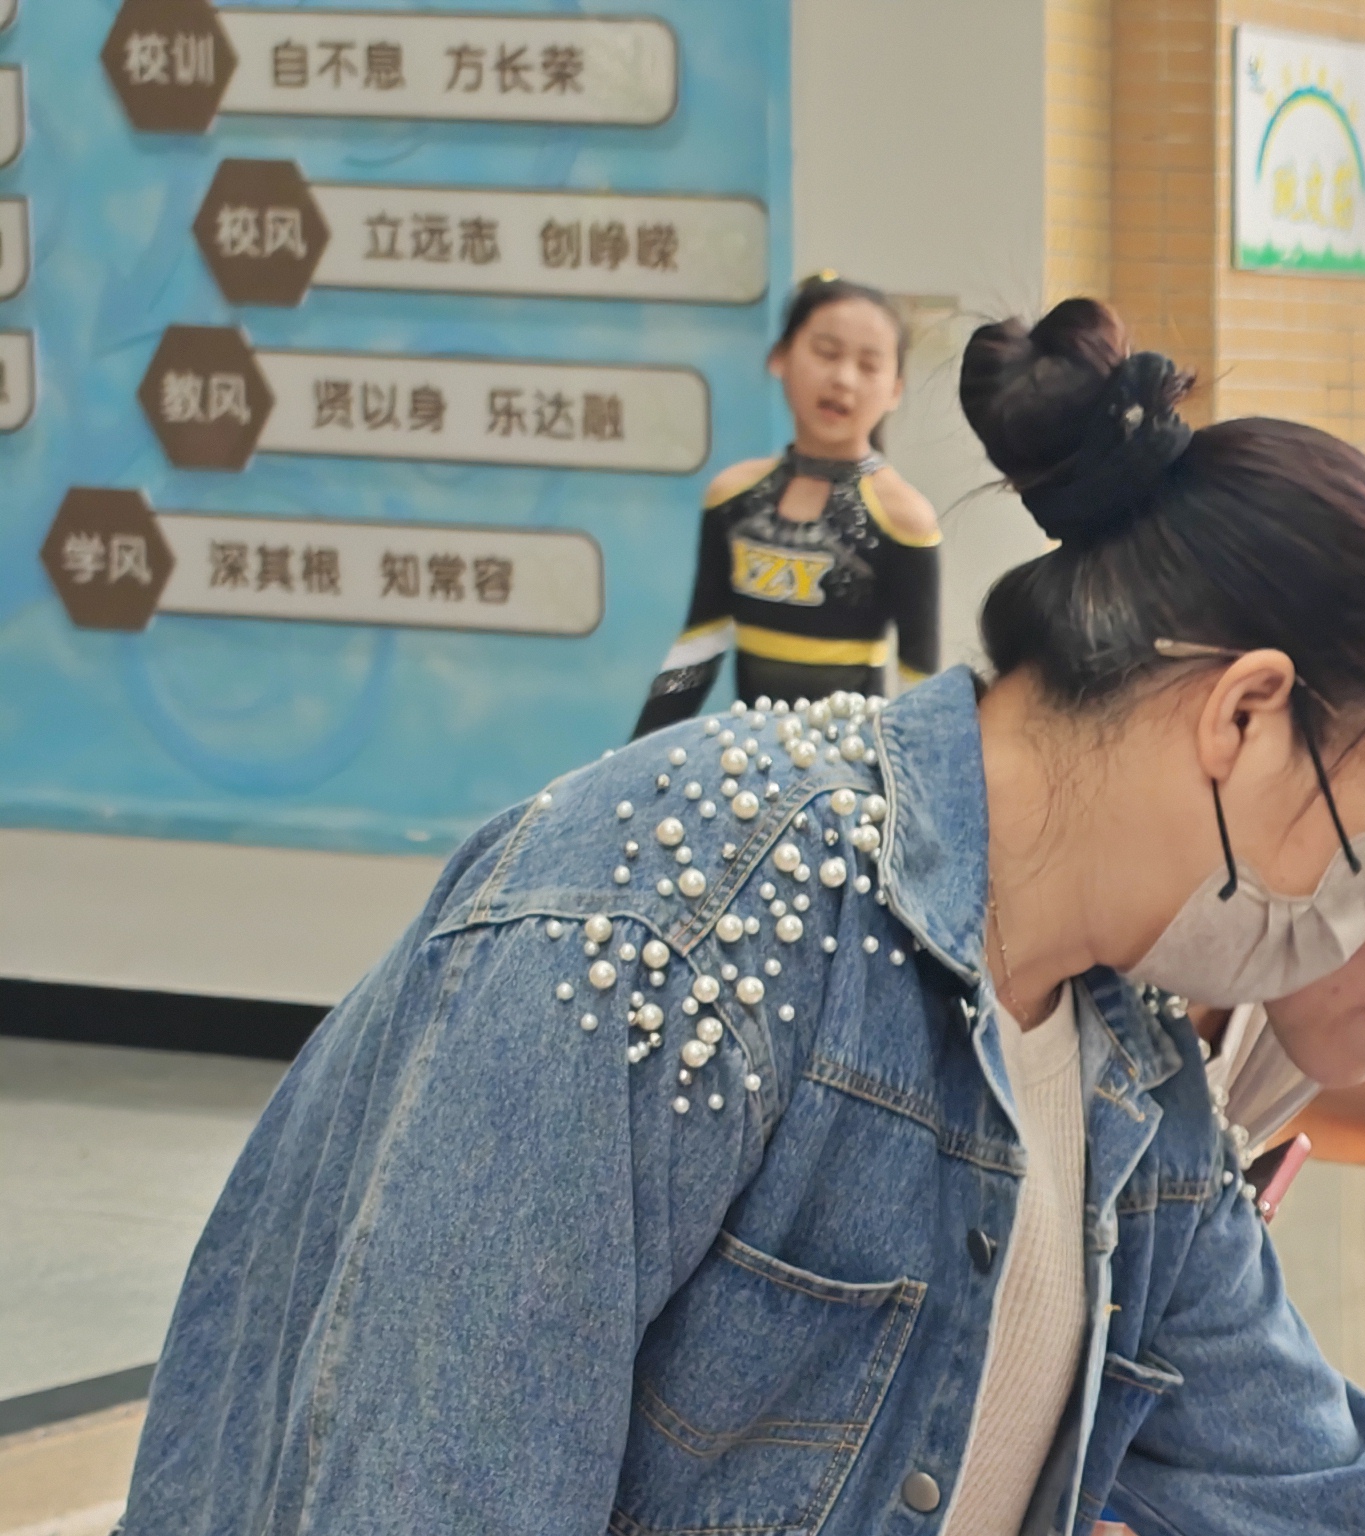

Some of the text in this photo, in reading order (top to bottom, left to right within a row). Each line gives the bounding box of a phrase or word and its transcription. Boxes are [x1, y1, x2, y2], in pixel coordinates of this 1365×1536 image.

[124, 32, 586, 94] 校训 自不息 方长荣
[215, 203, 679, 272] 校风 立远志 创峥嵘
[160, 369, 624, 441] 教风 贤以身 乐达融
[60, 530, 513, 605] 学风 深其根 知常容
